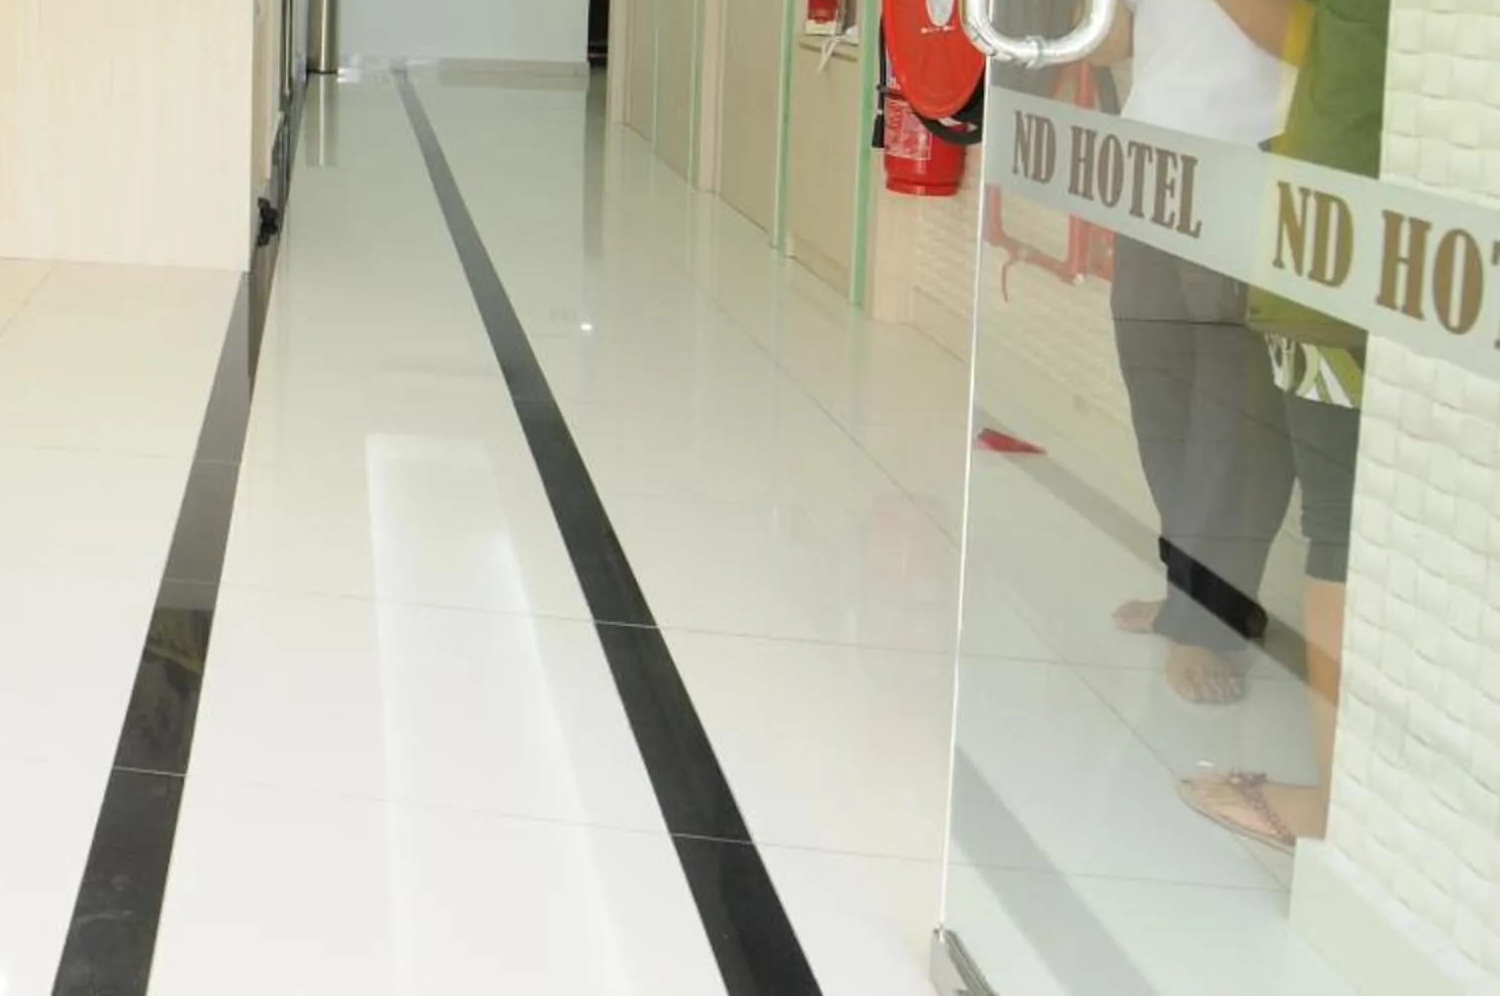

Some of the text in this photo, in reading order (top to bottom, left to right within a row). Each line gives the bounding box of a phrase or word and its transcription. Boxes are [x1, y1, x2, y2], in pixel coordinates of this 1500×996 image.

[1012, 109, 1057, 186] ND
[1067, 124, 1203, 240] HOTEL
[1272, 180, 1500, 351] ND HO
